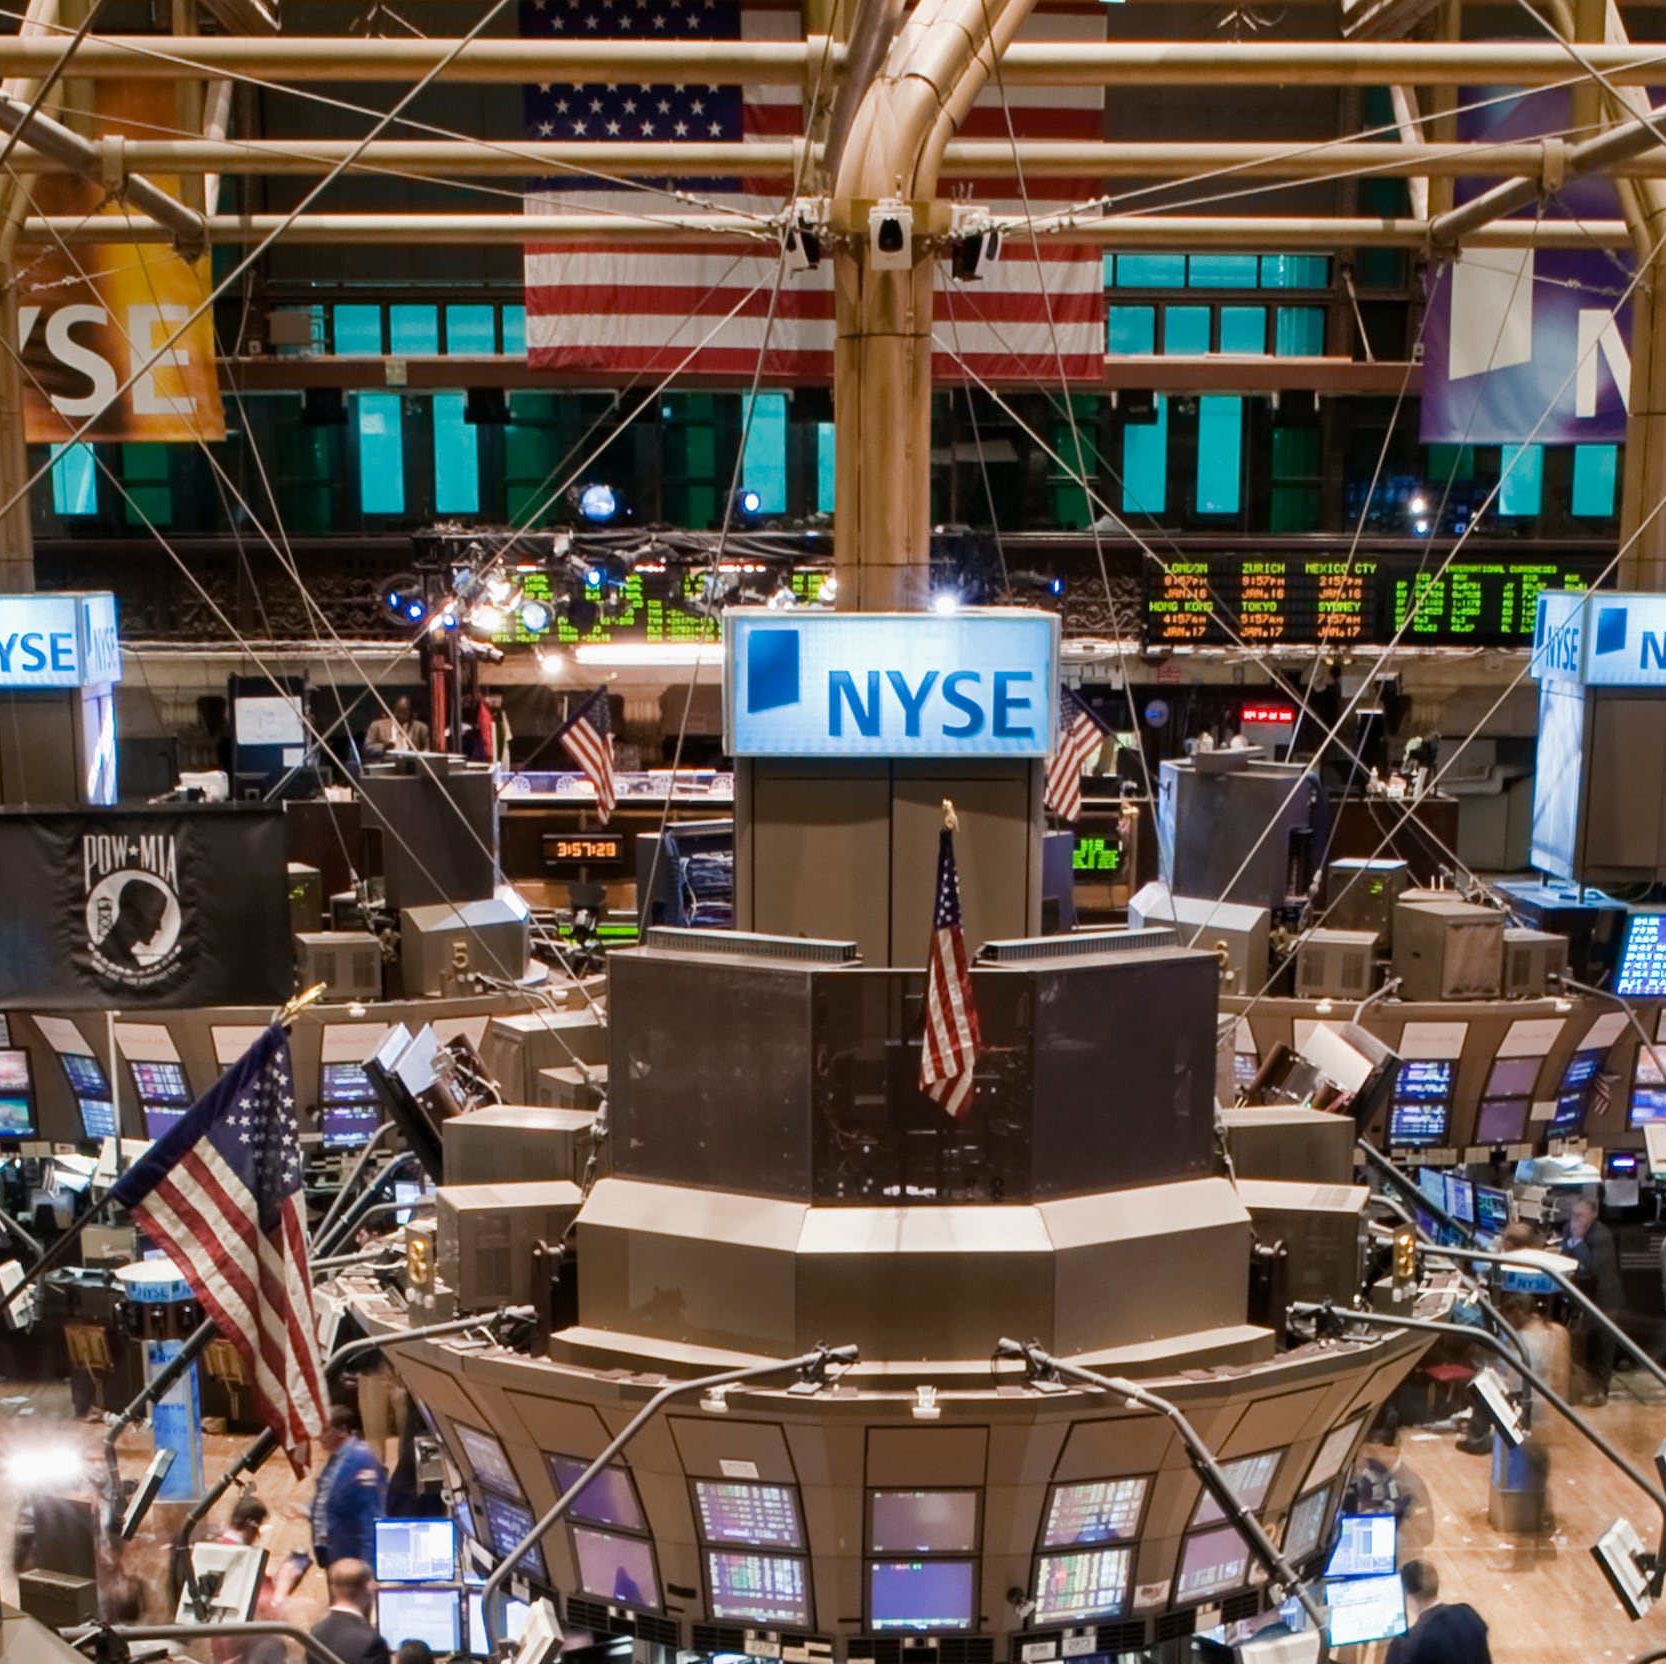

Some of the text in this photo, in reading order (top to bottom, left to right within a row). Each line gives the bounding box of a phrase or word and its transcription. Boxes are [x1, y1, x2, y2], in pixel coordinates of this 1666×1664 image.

[1241, 563, 1285, 574] ZURICH
[1149, 601, 1178, 612] HONG
[1241, 601, 1277, 612] TOKYO
[1544, 626, 1580, 672] NYSE
[828, 669, 1034, 738] NYSE
[83, 835, 180, 896] POW MIA
[453, 941, 468, 968] 5
[409, 1240, 428, 1285] 8
[138, 1286, 167, 1299] NYSE
